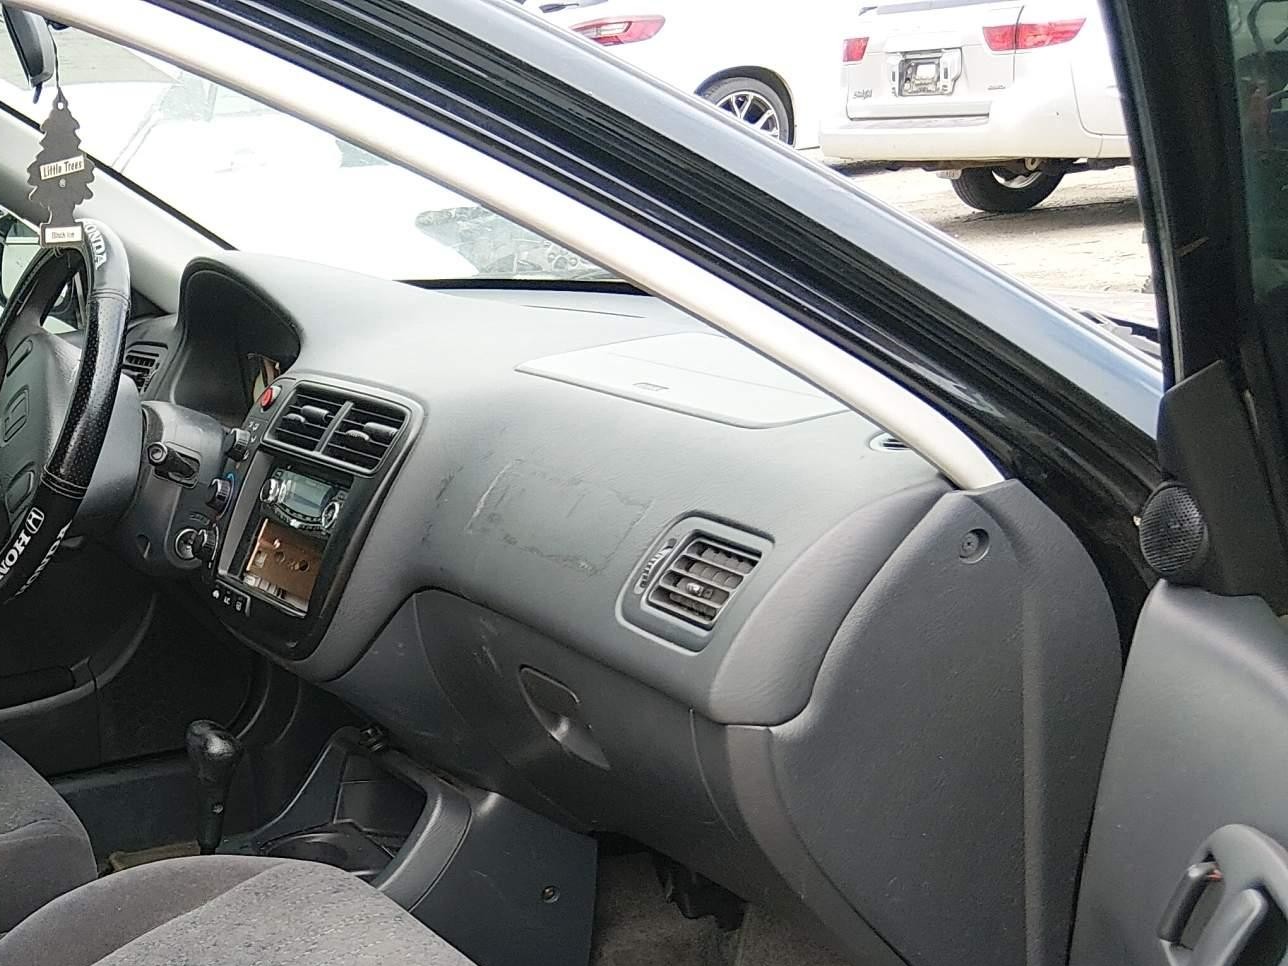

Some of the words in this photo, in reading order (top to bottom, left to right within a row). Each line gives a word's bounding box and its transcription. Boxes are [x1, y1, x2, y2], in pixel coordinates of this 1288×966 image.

[43, 164, 62, 178] Little
[64, 159, 83, 173] Trees
[84, 222, 107, 270] ONDA
